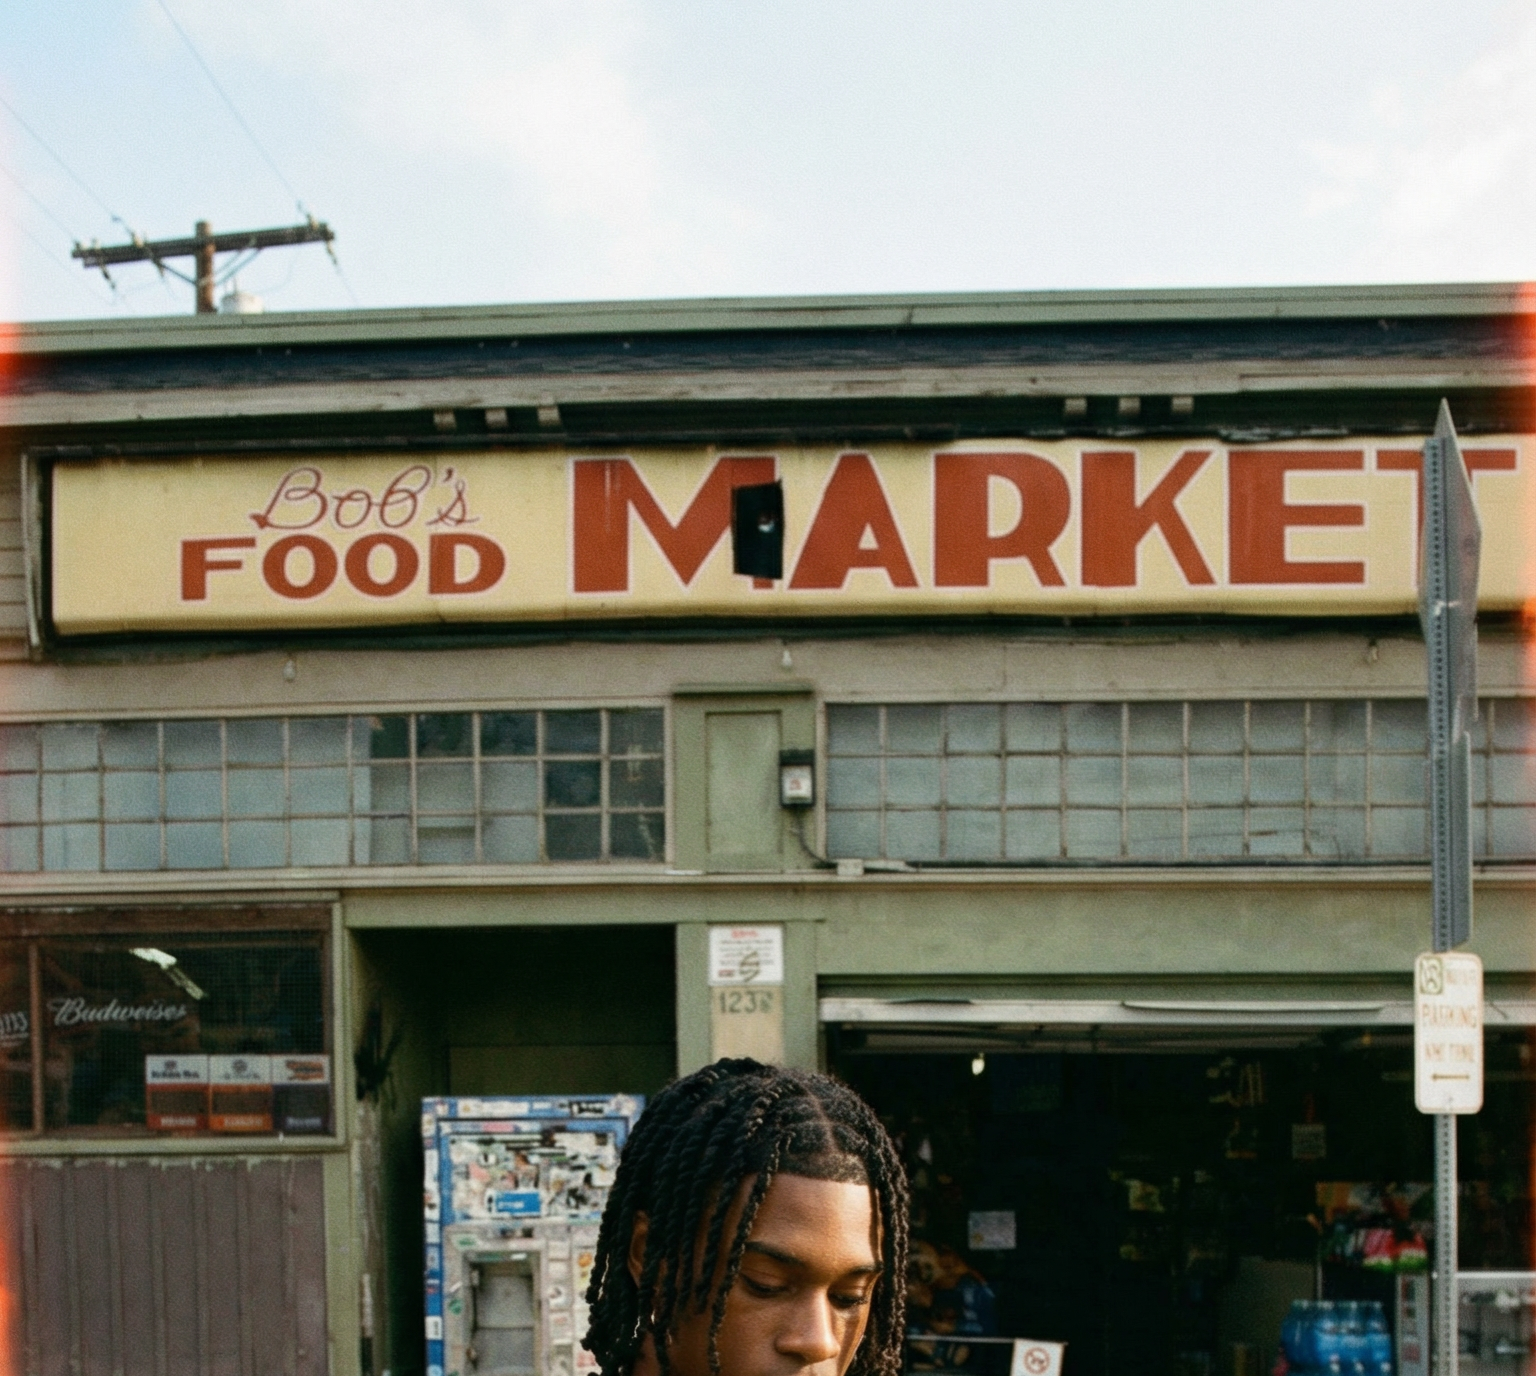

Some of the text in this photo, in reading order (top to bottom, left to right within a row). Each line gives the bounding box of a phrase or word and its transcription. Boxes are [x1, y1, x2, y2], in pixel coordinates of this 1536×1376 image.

[250, 465, 480, 529] Bob's
[181, 533, 506, 601] FOOD
[47, 997, 188, 1026] Budweiser
